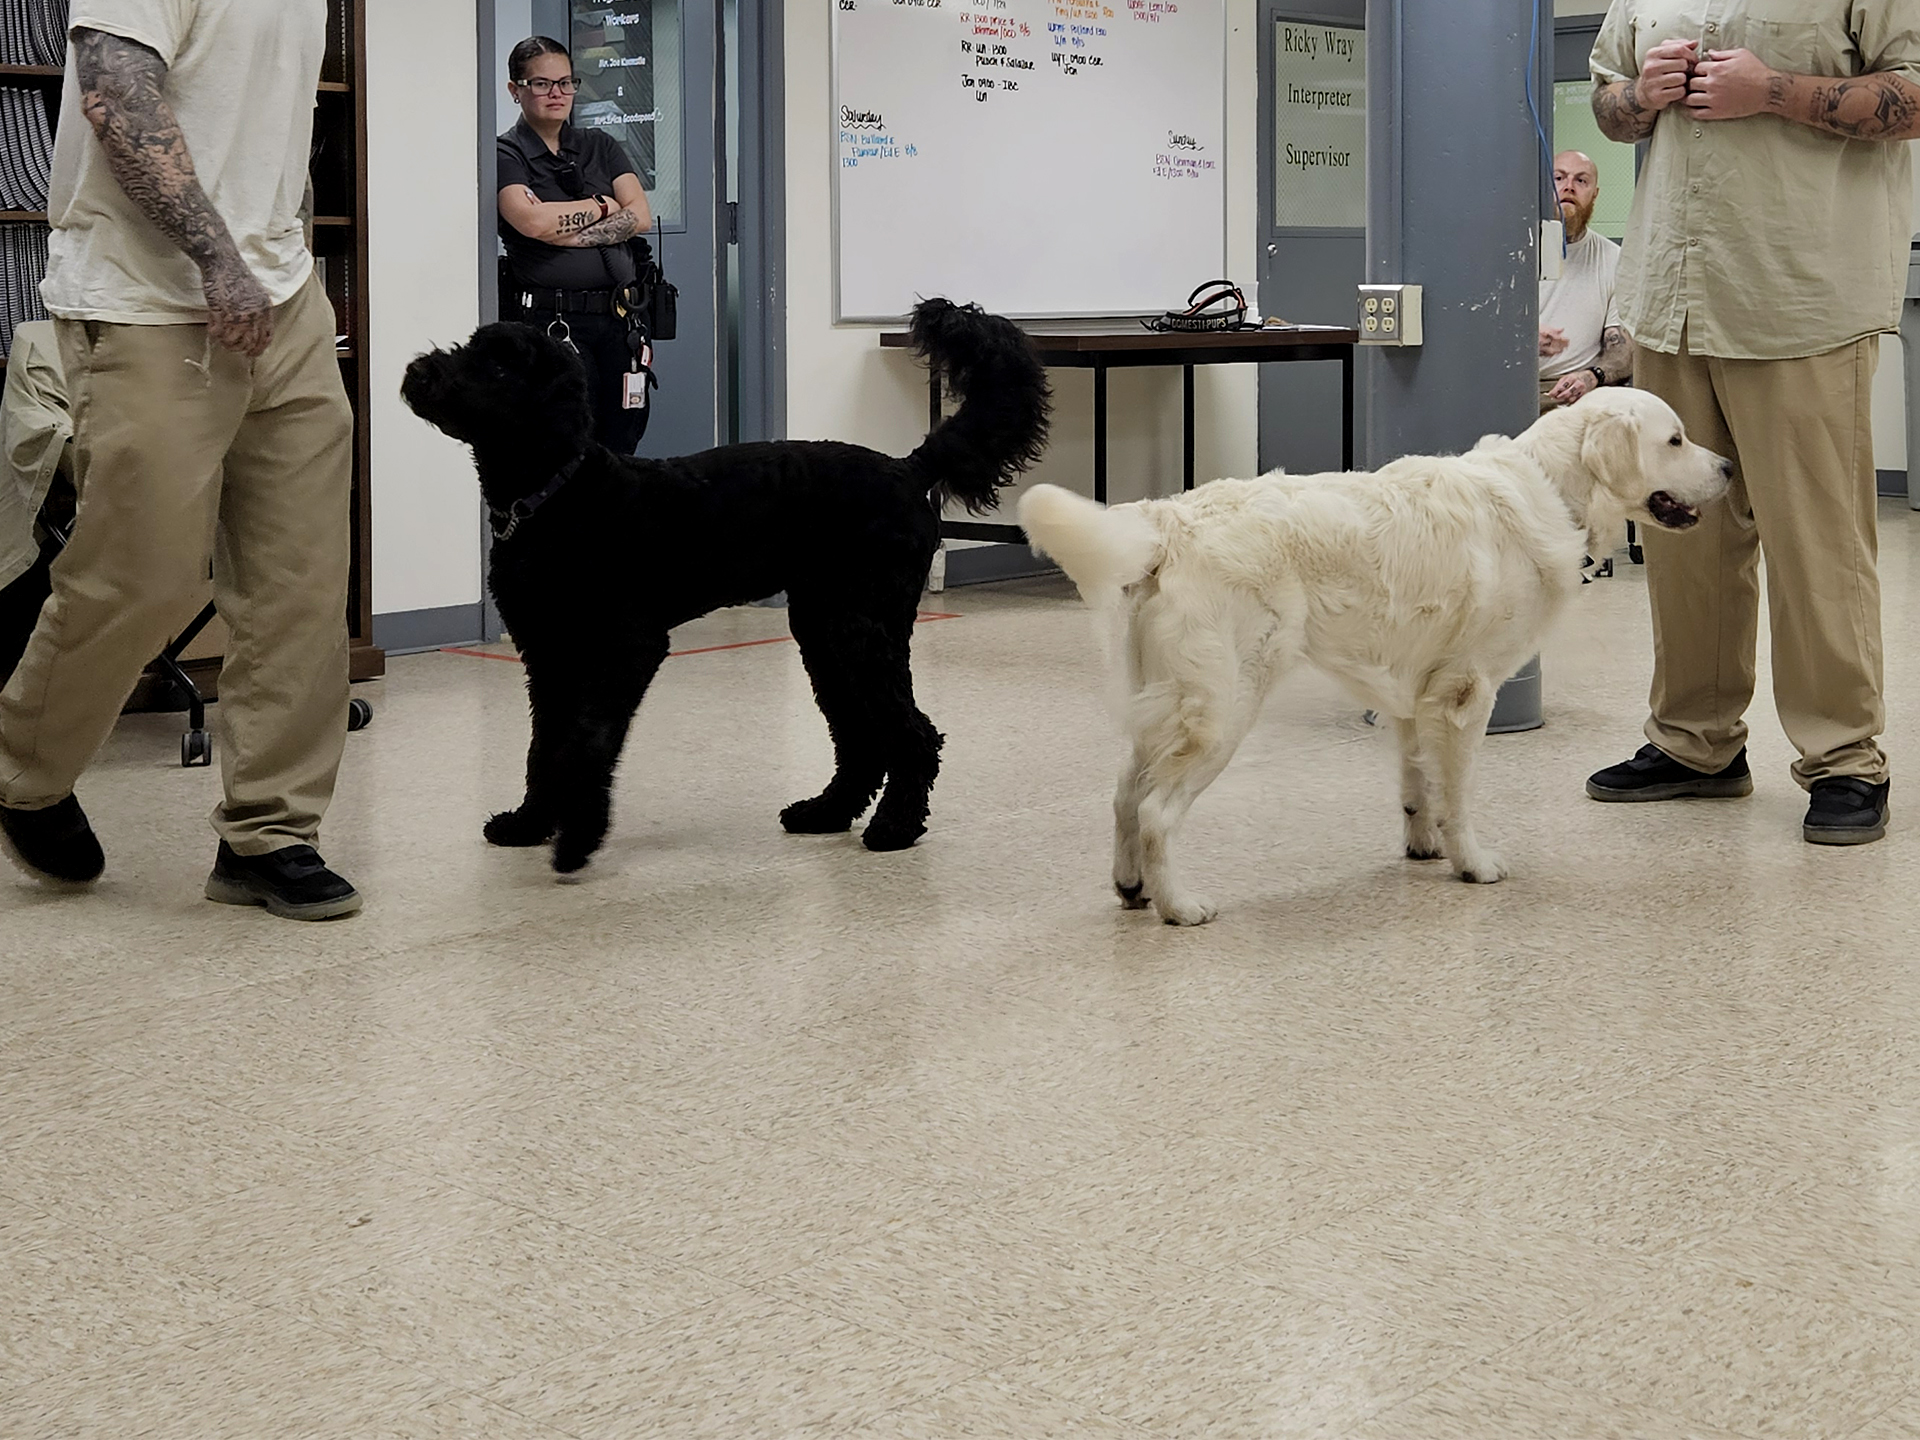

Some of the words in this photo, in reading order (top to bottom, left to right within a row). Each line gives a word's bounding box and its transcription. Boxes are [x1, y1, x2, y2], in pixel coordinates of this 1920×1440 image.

[604, 13, 640, 26] Workers
[1284, 27, 1318, 61] Ricky
[1324, 31, 1354, 63] Wray
[1288, 83, 1352, 110] Interpreter
[840, 104, 883, 130] Saturday
[1286, 143, 1350, 171] Supervisor
